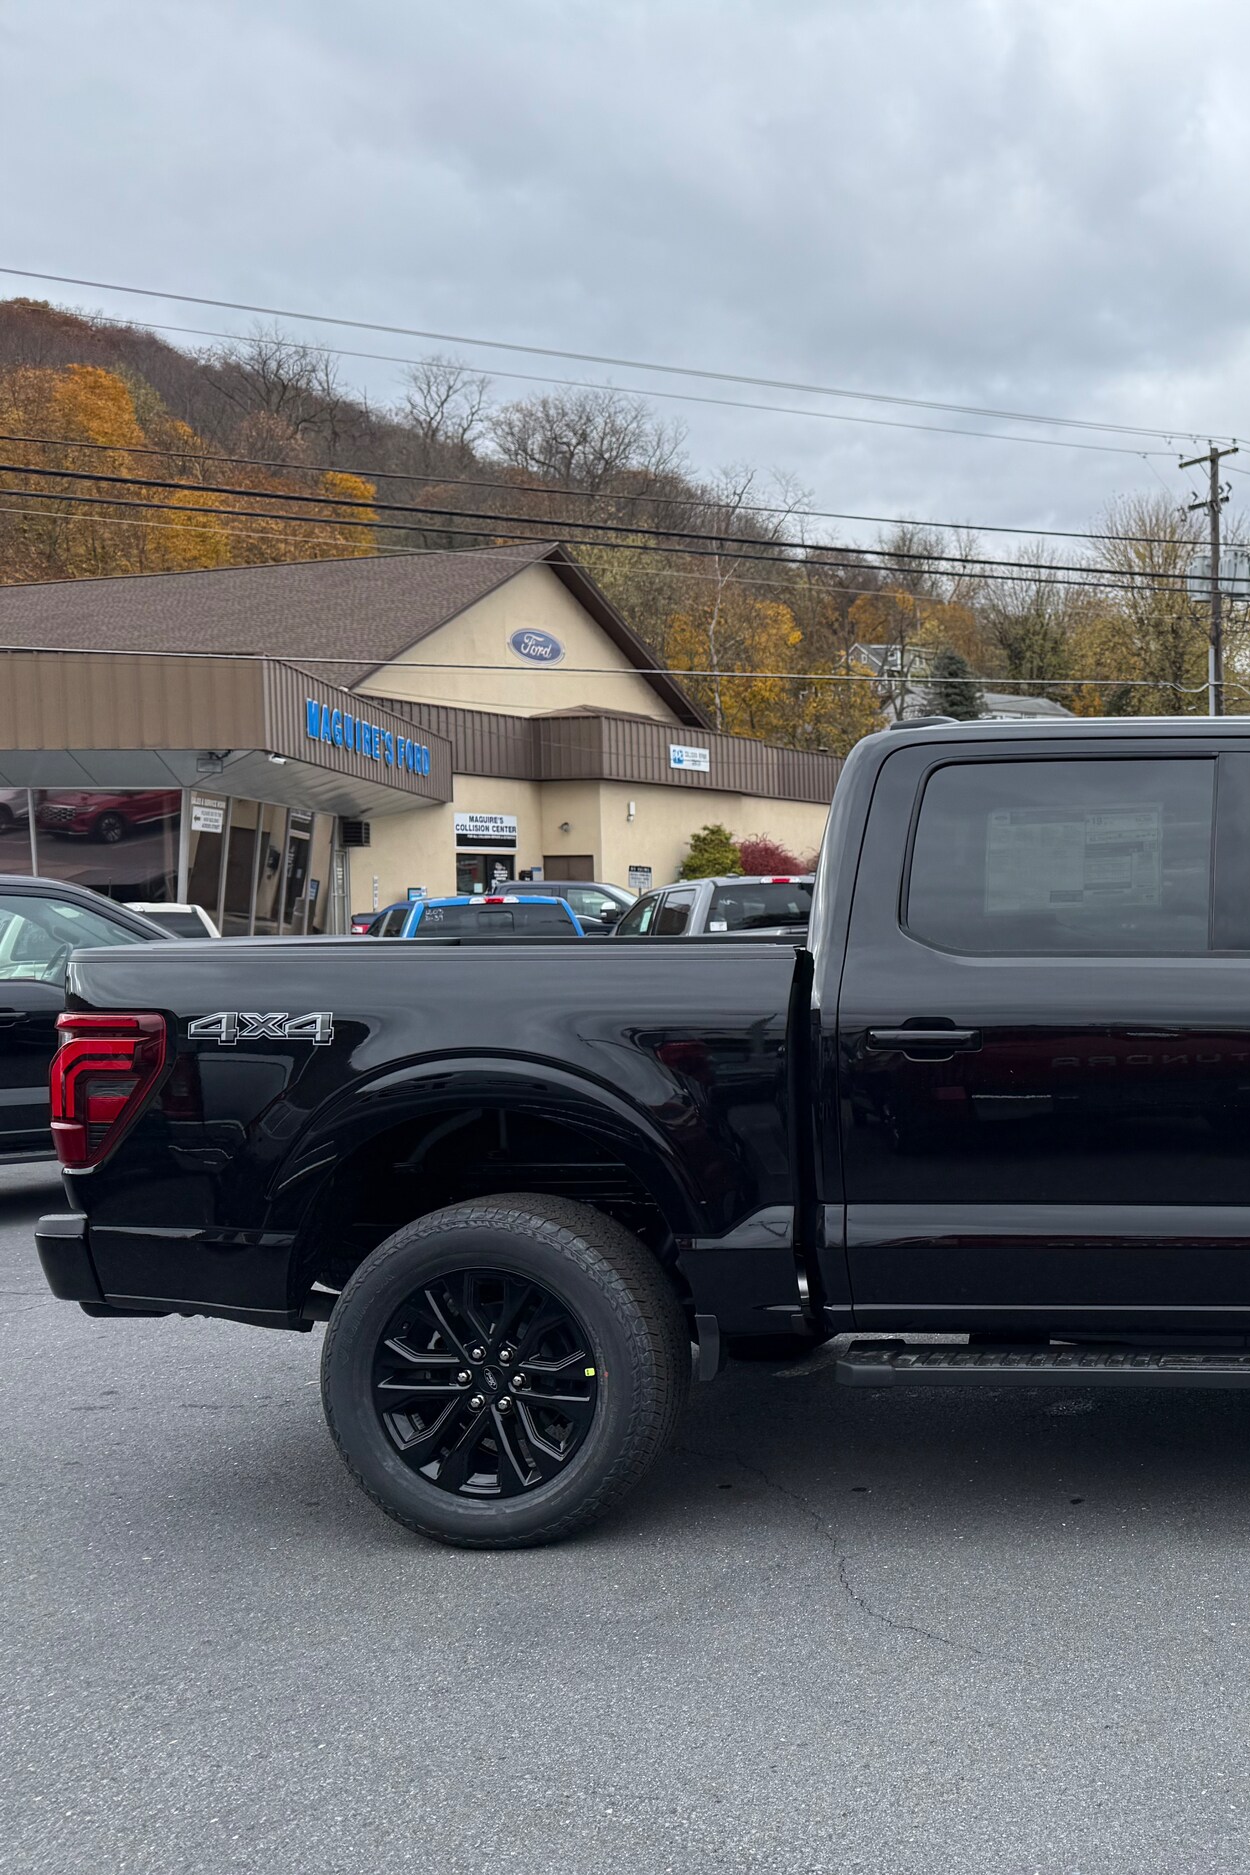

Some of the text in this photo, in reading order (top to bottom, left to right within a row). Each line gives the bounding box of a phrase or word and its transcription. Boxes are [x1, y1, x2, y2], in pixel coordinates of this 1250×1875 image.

[521, 633, 552, 659] Ford
[306, 698, 430, 777] MAGUIRE'S FORD
[455, 823, 517, 834] COLLISION CENTER
[468, 815, 504, 825] MAGUIRE'S
